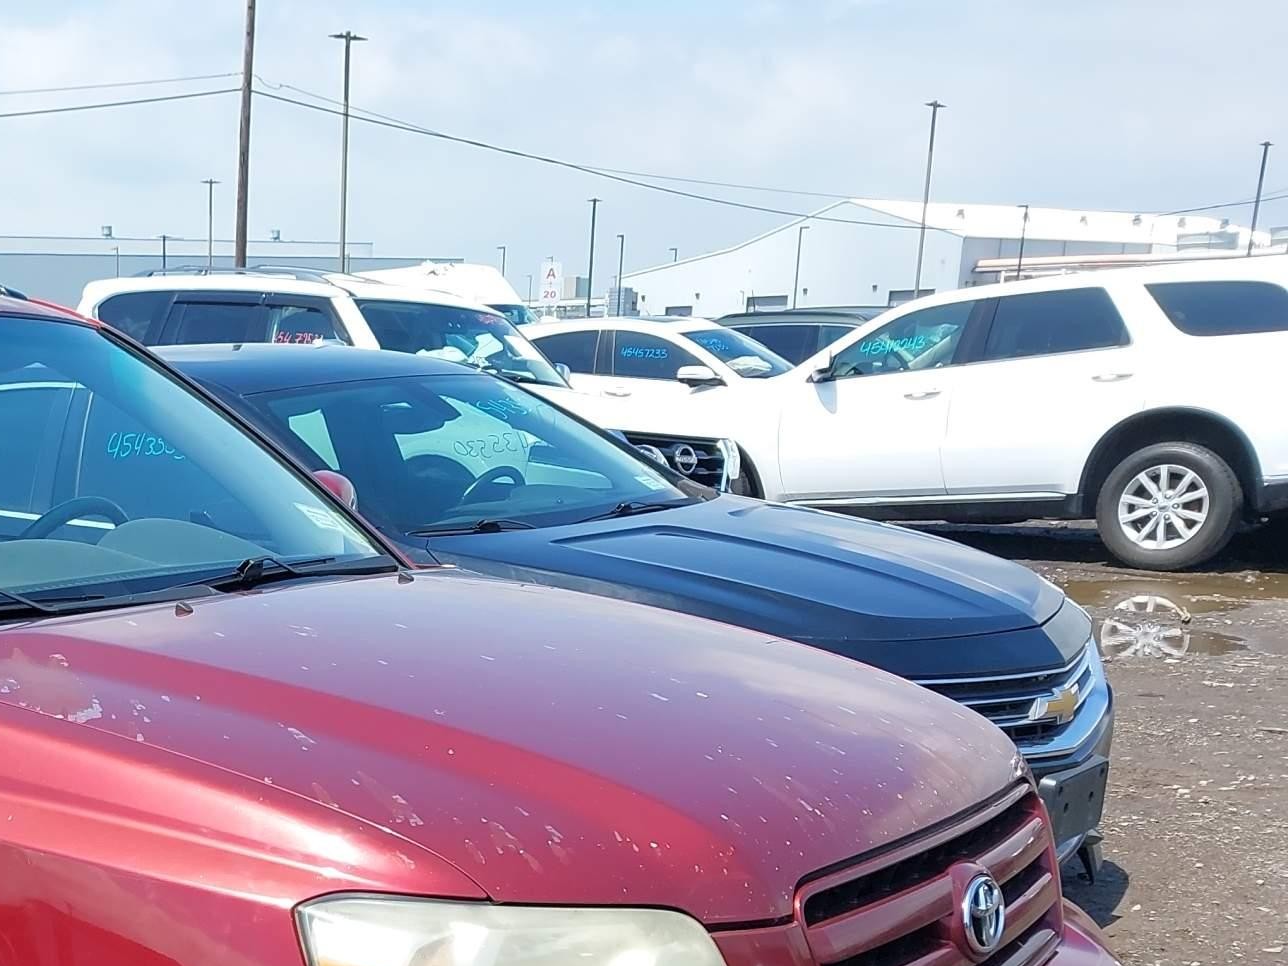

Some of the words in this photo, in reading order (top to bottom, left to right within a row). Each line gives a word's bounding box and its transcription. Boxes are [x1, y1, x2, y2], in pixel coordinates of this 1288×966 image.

[546, 267, 556, 280] A
[543, 290, 557, 299] 20
[620, 346, 668, 359] 45457233
